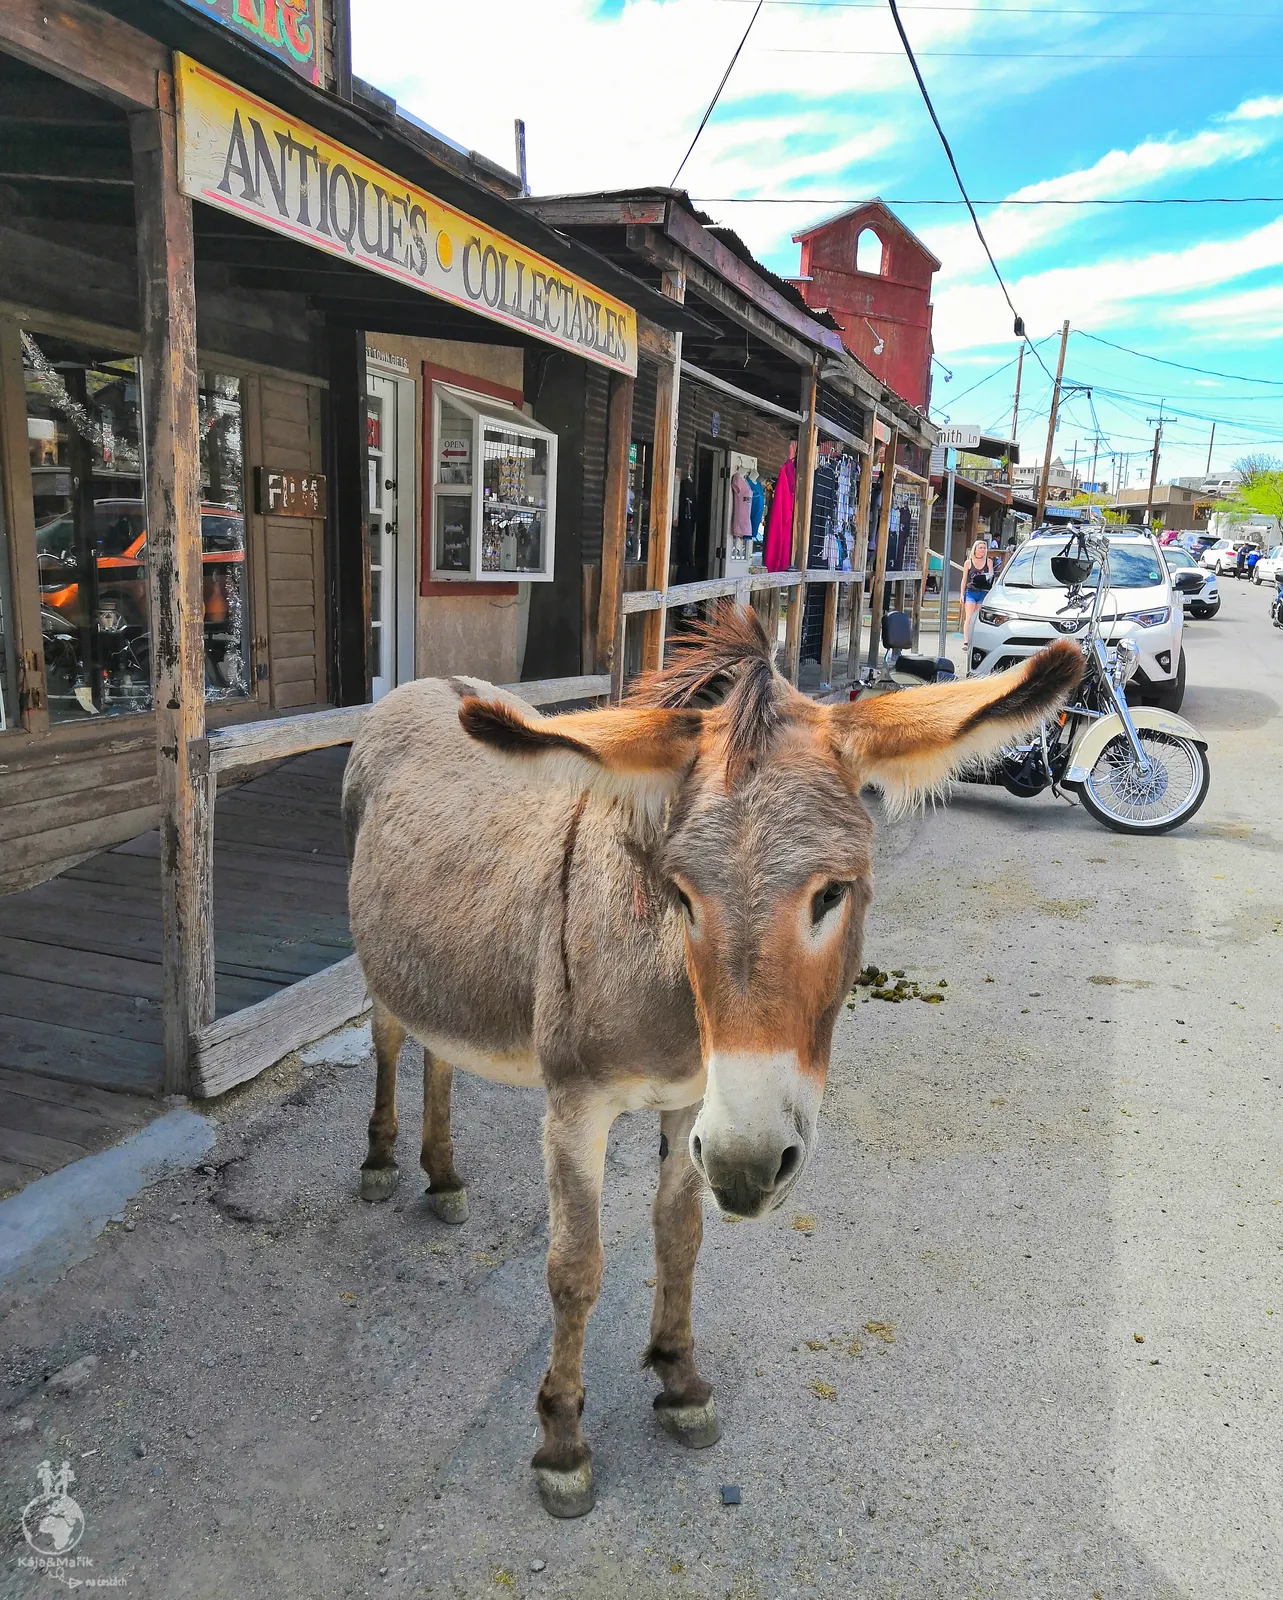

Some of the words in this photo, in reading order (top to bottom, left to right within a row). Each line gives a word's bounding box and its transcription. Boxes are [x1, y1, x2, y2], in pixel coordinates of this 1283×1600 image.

[217, 108, 428, 277] ANTIQUE'S
[463, 235, 627, 362] COLLECTABLES
[391, 354, 408, 368] GIFTS
[938, 429, 962, 443] mith
[969, 434, 978, 444] Ln
[444, 440, 465, 448] OPEN
